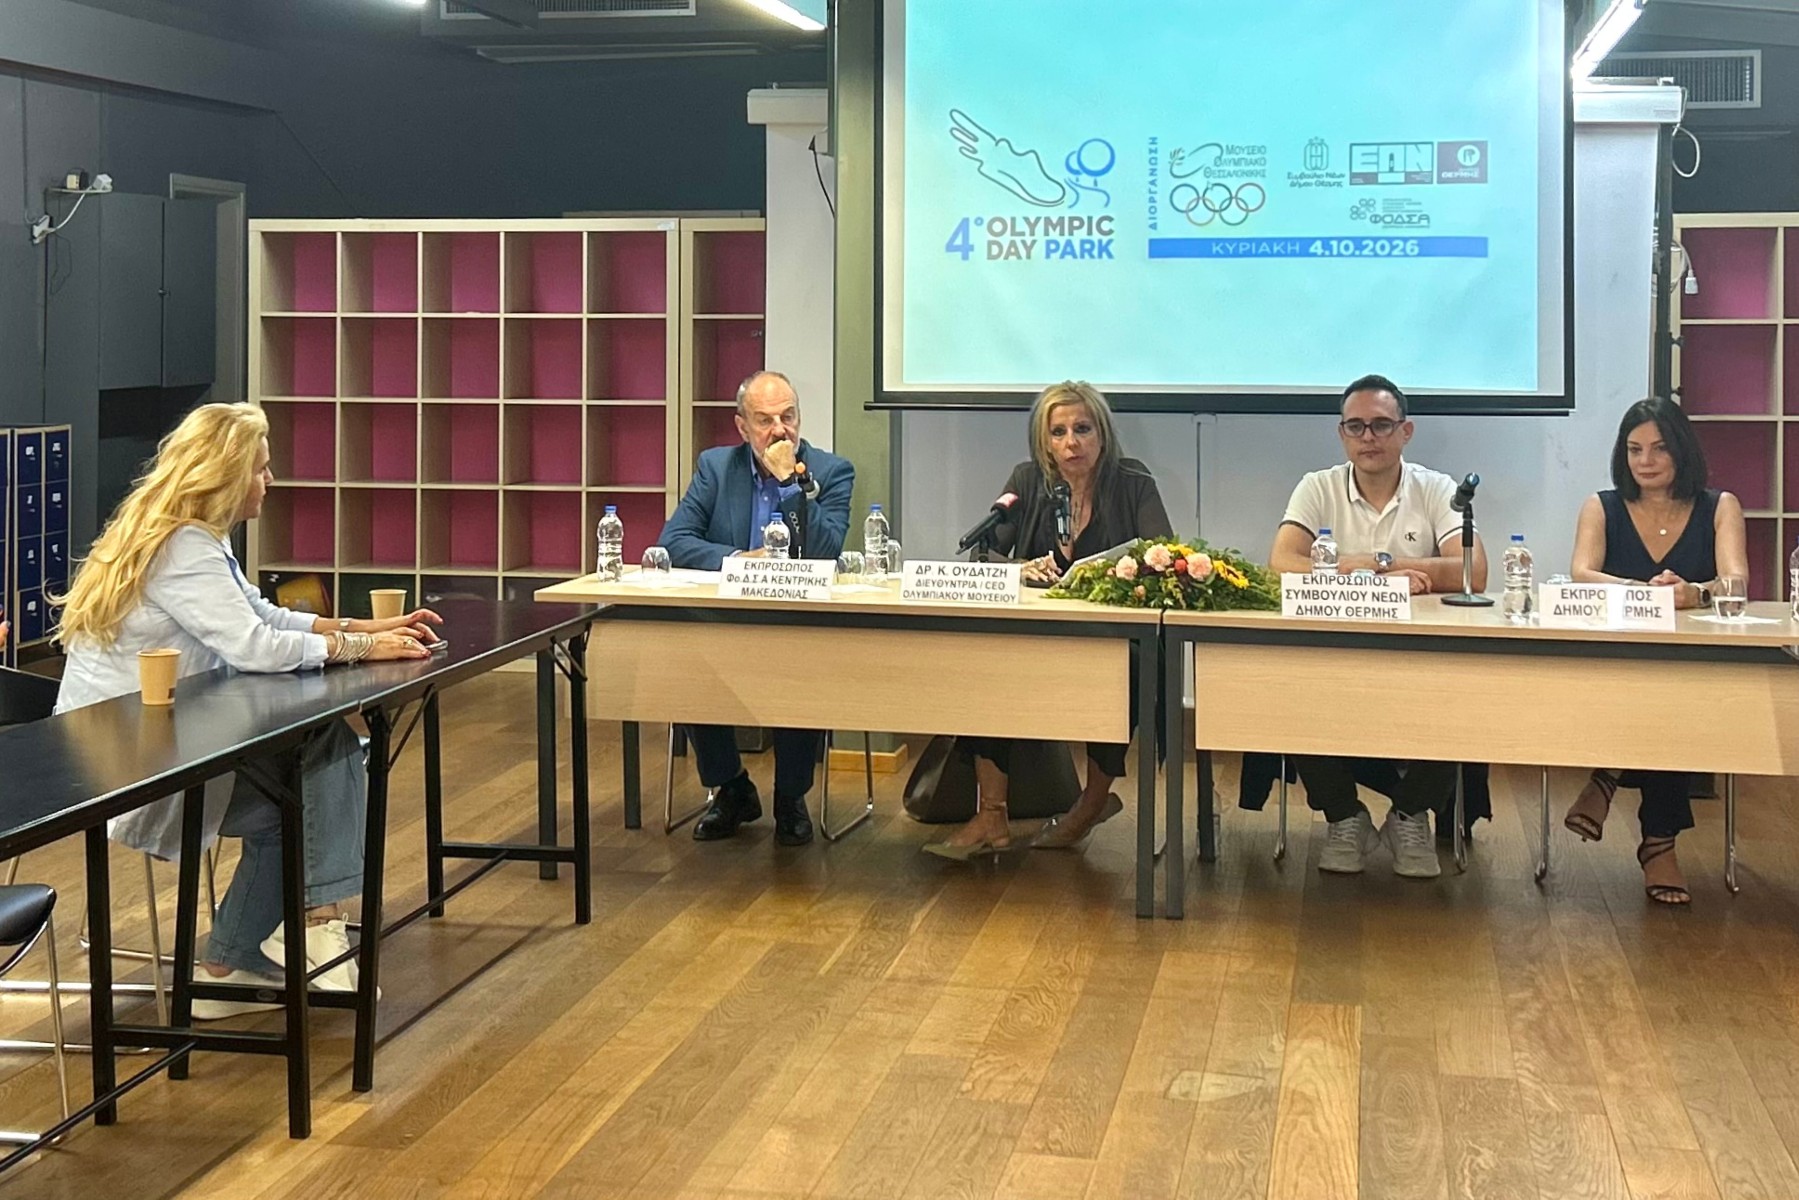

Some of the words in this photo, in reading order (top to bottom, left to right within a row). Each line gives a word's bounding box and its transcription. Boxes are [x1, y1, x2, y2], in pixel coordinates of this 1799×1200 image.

[1148, 136, 1159, 231] ΔΙΟΡΓΑΝΩΣΗ
[986, 215, 1115, 238] OLYMPIC
[986, 239, 1038, 260] DAY
[1044, 238, 1114, 260] PARK
[1211, 241, 1300, 255] ΚΥΡΙΑΚΗ
[1308, 239, 1420, 256] 4.10.2026
[744, 560, 814, 573] ΕΚΠΡΟΣΩΠΟΣ
[952, 566, 1008, 578] ΟΥΔΑΤΖΗ
[771, 575, 828, 587] ΚΕΝΤΡΙΚΗΣ
[915, 578, 978, 589] ΔΙΕΥΘΥΝΤΡΙΑ
[985, 580, 1006, 591] CEO
[1302, 574, 1390, 587] ΕΚΠΡΟΣΩΠΟΣ
[741, 586, 809, 600] ΜΑΚΕΔΟΝΙΑΣ
[902, 589, 965, 601] ΟΛΥΜΠΙΑΚΟΥ
[967, 591, 1016, 603] ΜΟΥΣΕΙΟΥ
[1285, 588, 1368, 601] ΣΥΜΒΟΥΛΙΟΥ
[1371, 591, 1408, 603] ΝΕΩΝ
[1295, 604, 1341, 617] ΔΗΜΟΥ
[1345, 606, 1399, 618] ΘΕΡΜΗΣ
[1553, 604, 1602, 617] ΔΗΜΟΥ
